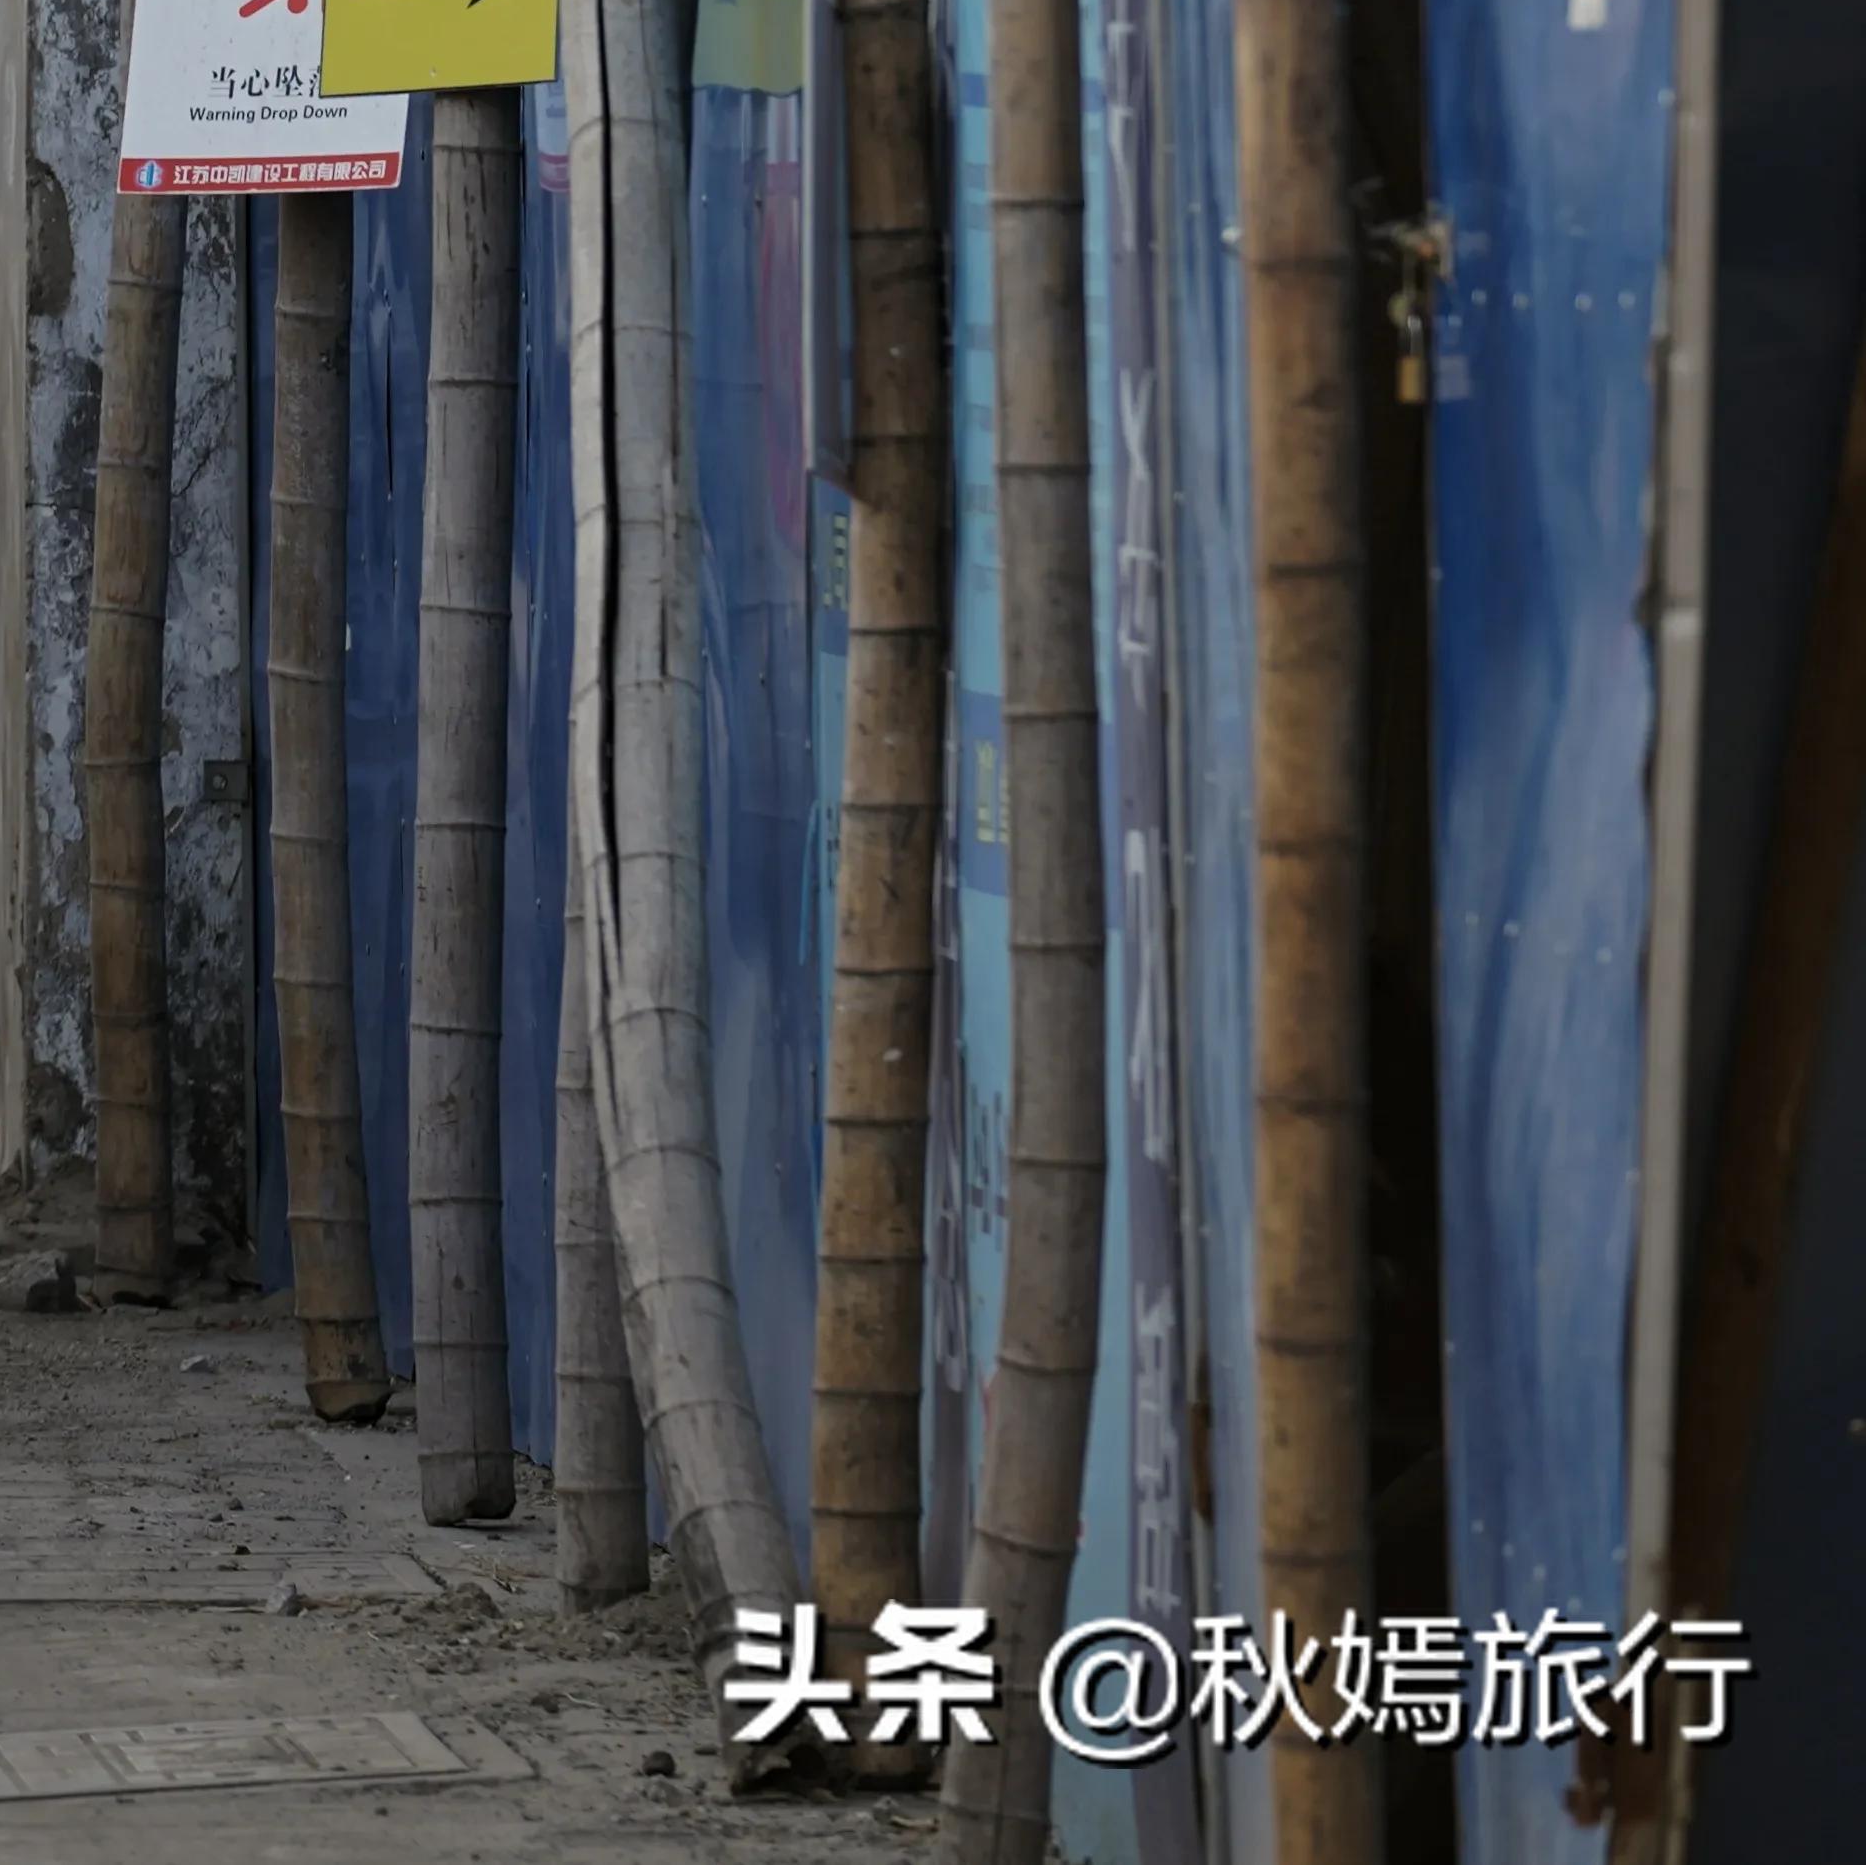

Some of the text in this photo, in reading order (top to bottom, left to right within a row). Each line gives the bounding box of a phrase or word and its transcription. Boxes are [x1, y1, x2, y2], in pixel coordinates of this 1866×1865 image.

[189, 104, 348, 124] Warning Drop Down
[172, 159, 387, 185] 江苏中凯建设工程有限公司
